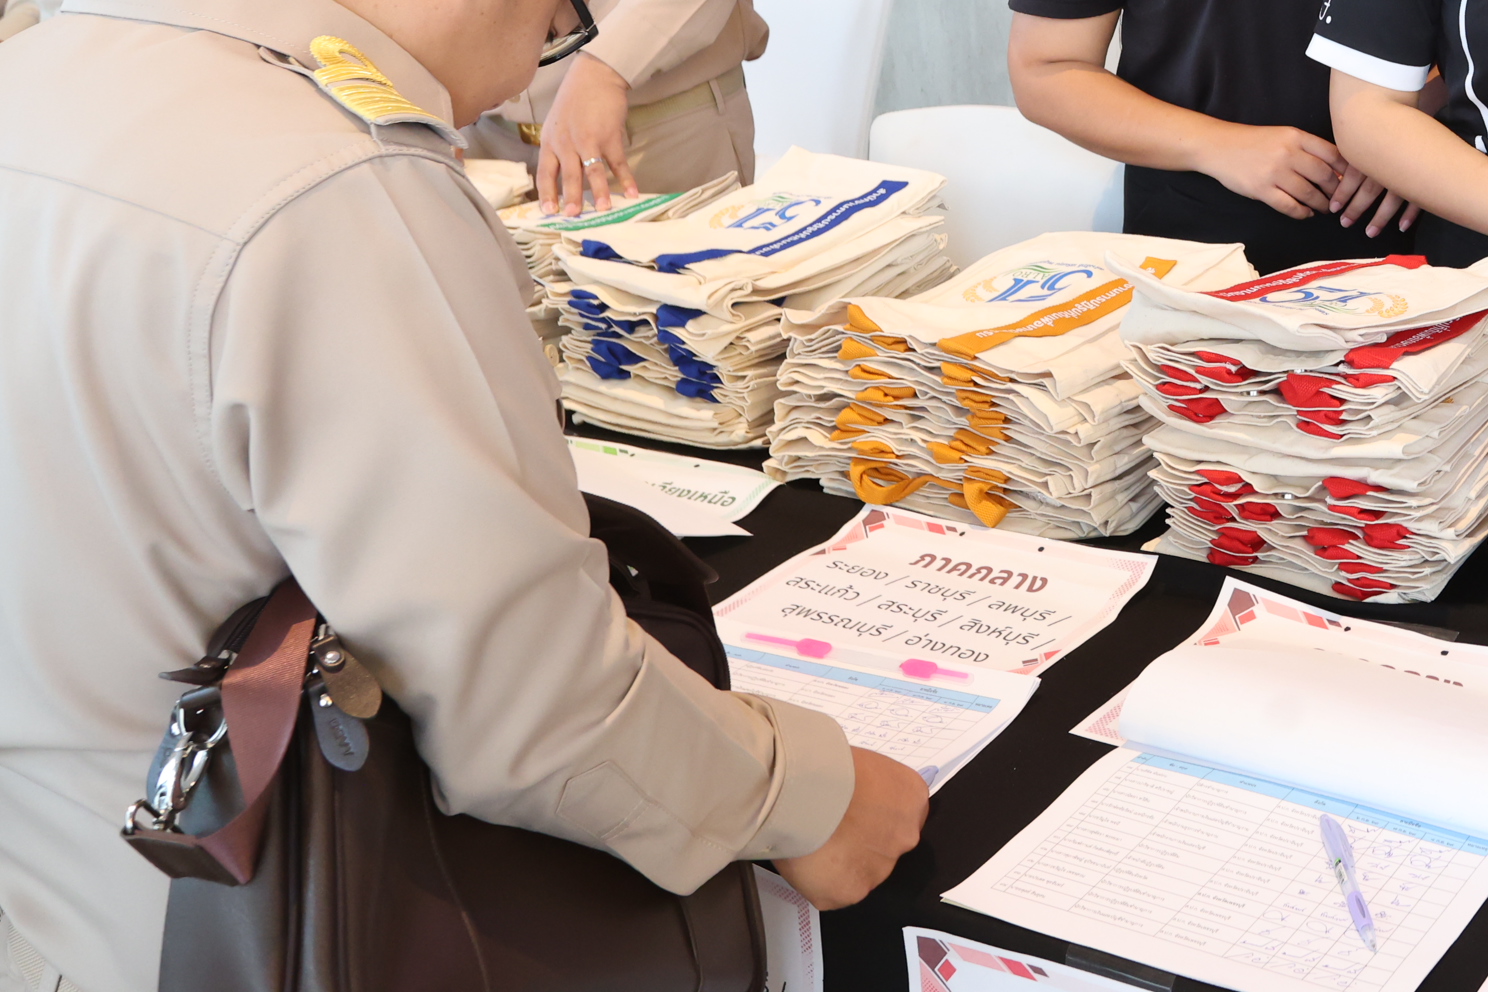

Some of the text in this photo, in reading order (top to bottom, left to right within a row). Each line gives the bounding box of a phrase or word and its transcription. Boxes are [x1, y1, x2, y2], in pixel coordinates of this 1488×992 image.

[985, 269, 1094, 304] 51
[826, 558, 889, 580] ระยอง
[905, 577, 976, 602] ราชบุรี
[987, 598, 1057, 623] ลพบุรี
[908, 553, 1049, 593] ภาคกลาง
[781, 602, 894, 637] สุพรรณบุรี
[905, 633, 990, 663] อ่างทอง
[785, 574, 861, 602] สระแก้ว
[877, 598, 949, 625] สระบุรี
[959, 617, 1040, 646] สิงห์บุรี
